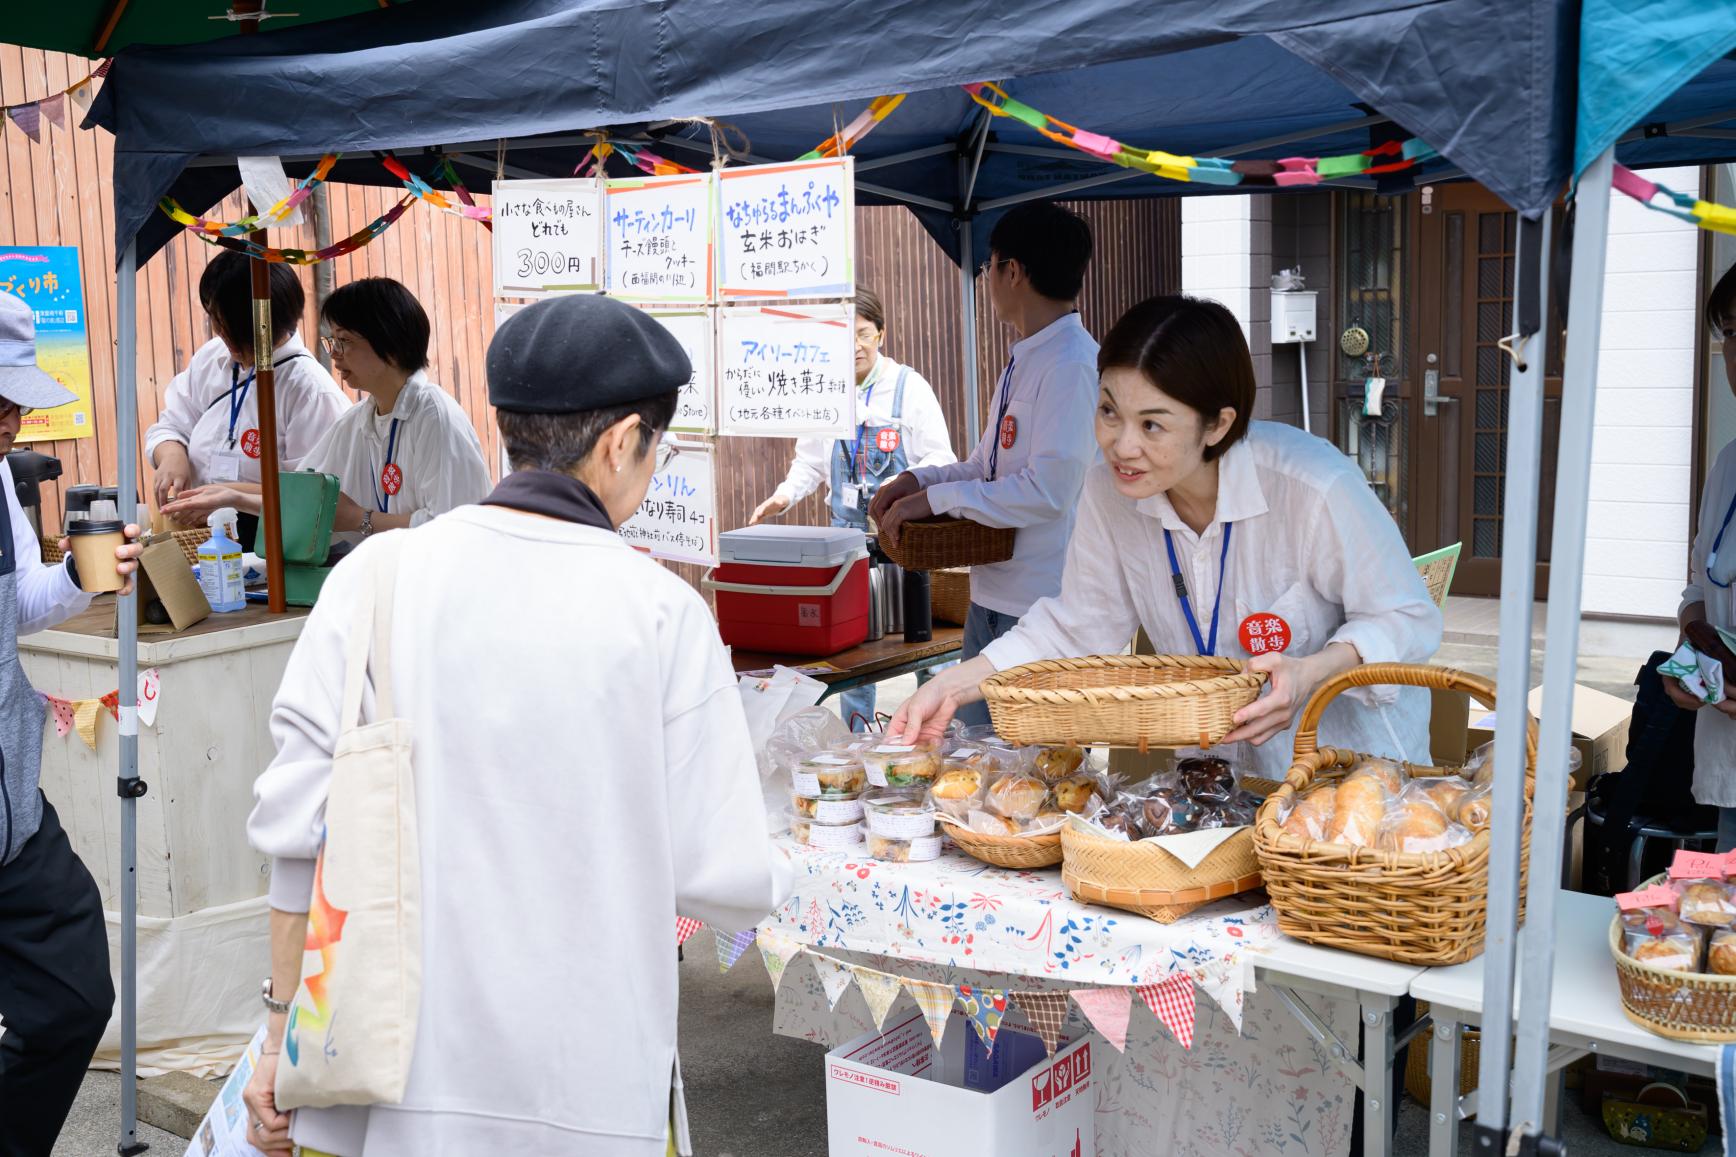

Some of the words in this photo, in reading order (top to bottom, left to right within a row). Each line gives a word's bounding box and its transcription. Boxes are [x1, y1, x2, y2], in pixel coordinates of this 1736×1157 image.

[501, 198, 592, 219] 小さな食べもの屋さん
[725, 181, 840, 229] なちゅらるまんぷくや
[531, 220, 569, 238] どれでも
[740, 225, 826, 253] 玄米おはぎ
[517, 247, 580, 278] 300円
[665, 253, 696, 270] クッキー
[741, 341, 831, 364] アイリーカフェ
[725, 366, 761, 381] からだに
[740, 381, 765, 399] 優しい
[1246, 618, 1283, 637] 音楽
[1249, 635, 1284, 653] 散歩
